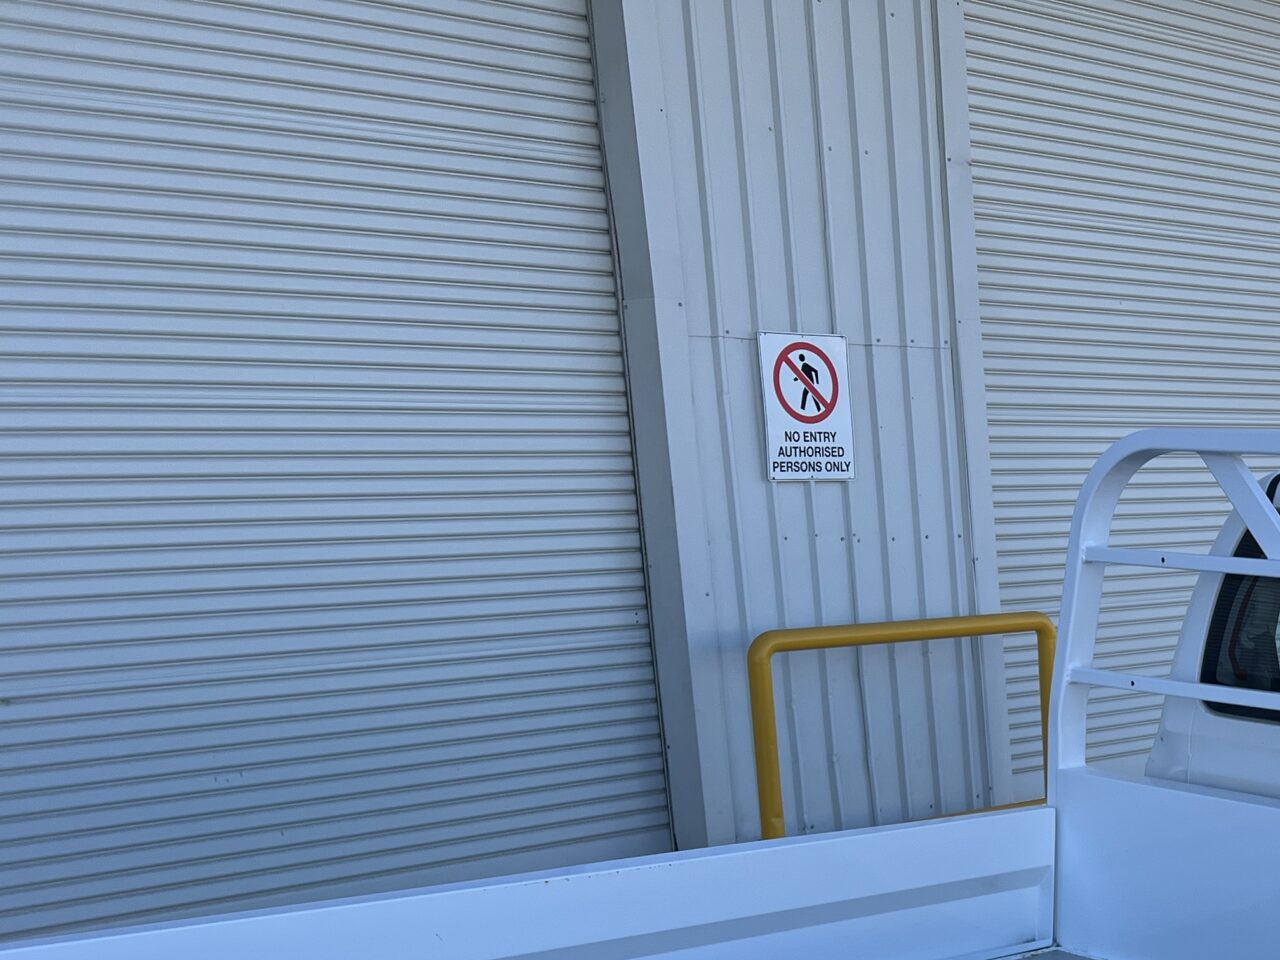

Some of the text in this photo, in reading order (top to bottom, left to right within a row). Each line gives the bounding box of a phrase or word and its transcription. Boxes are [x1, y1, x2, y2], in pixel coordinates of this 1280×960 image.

[784, 431, 837, 442] NO ENTRY
[778, 446, 844, 457] AUTHORISED
[772, 461, 851, 472] PERSONS ONLY
